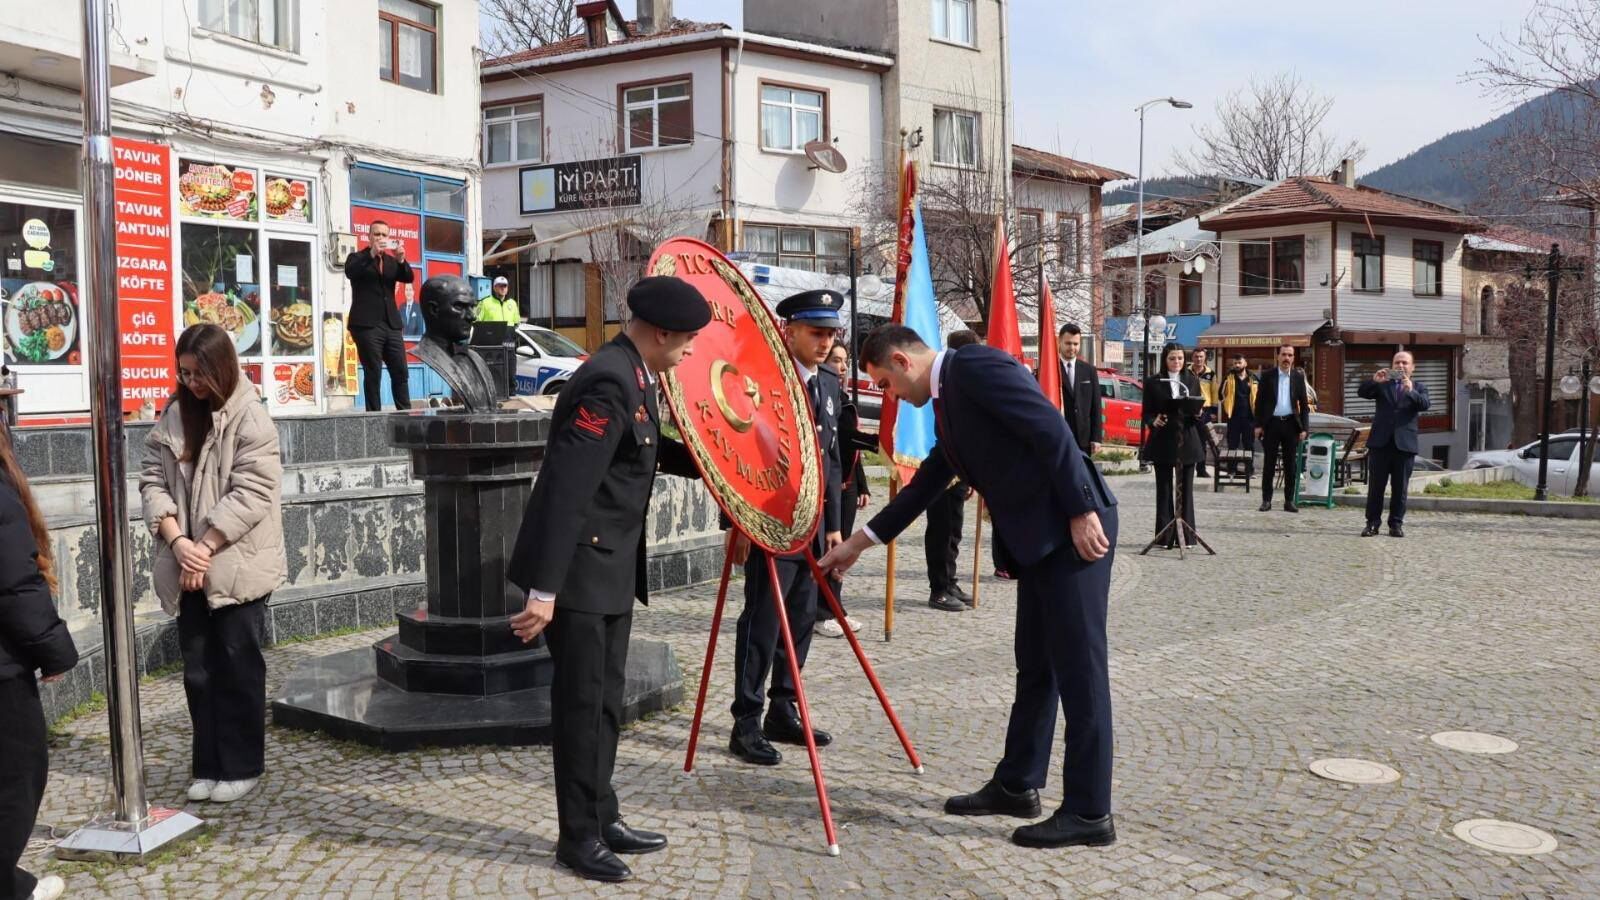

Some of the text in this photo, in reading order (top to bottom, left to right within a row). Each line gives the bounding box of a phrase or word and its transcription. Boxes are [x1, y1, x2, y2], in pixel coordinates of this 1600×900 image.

[115, 146, 161, 166] TAVUK
[115, 166, 162, 185] DÖNER
[559, 193, 577, 204] KÜRE
[117, 201, 163, 218] TAVUK
[116, 256, 168, 272] IZGARA
[120, 275, 165, 291] KÖFTE
[132, 312, 156, 328] ÇİĞ
[709, 300, 737, 330] RE
[122, 332, 167, 346] KÖFTE
[122, 367, 169, 379] SUCUK
[122, 387, 170, 399] EKMEK
